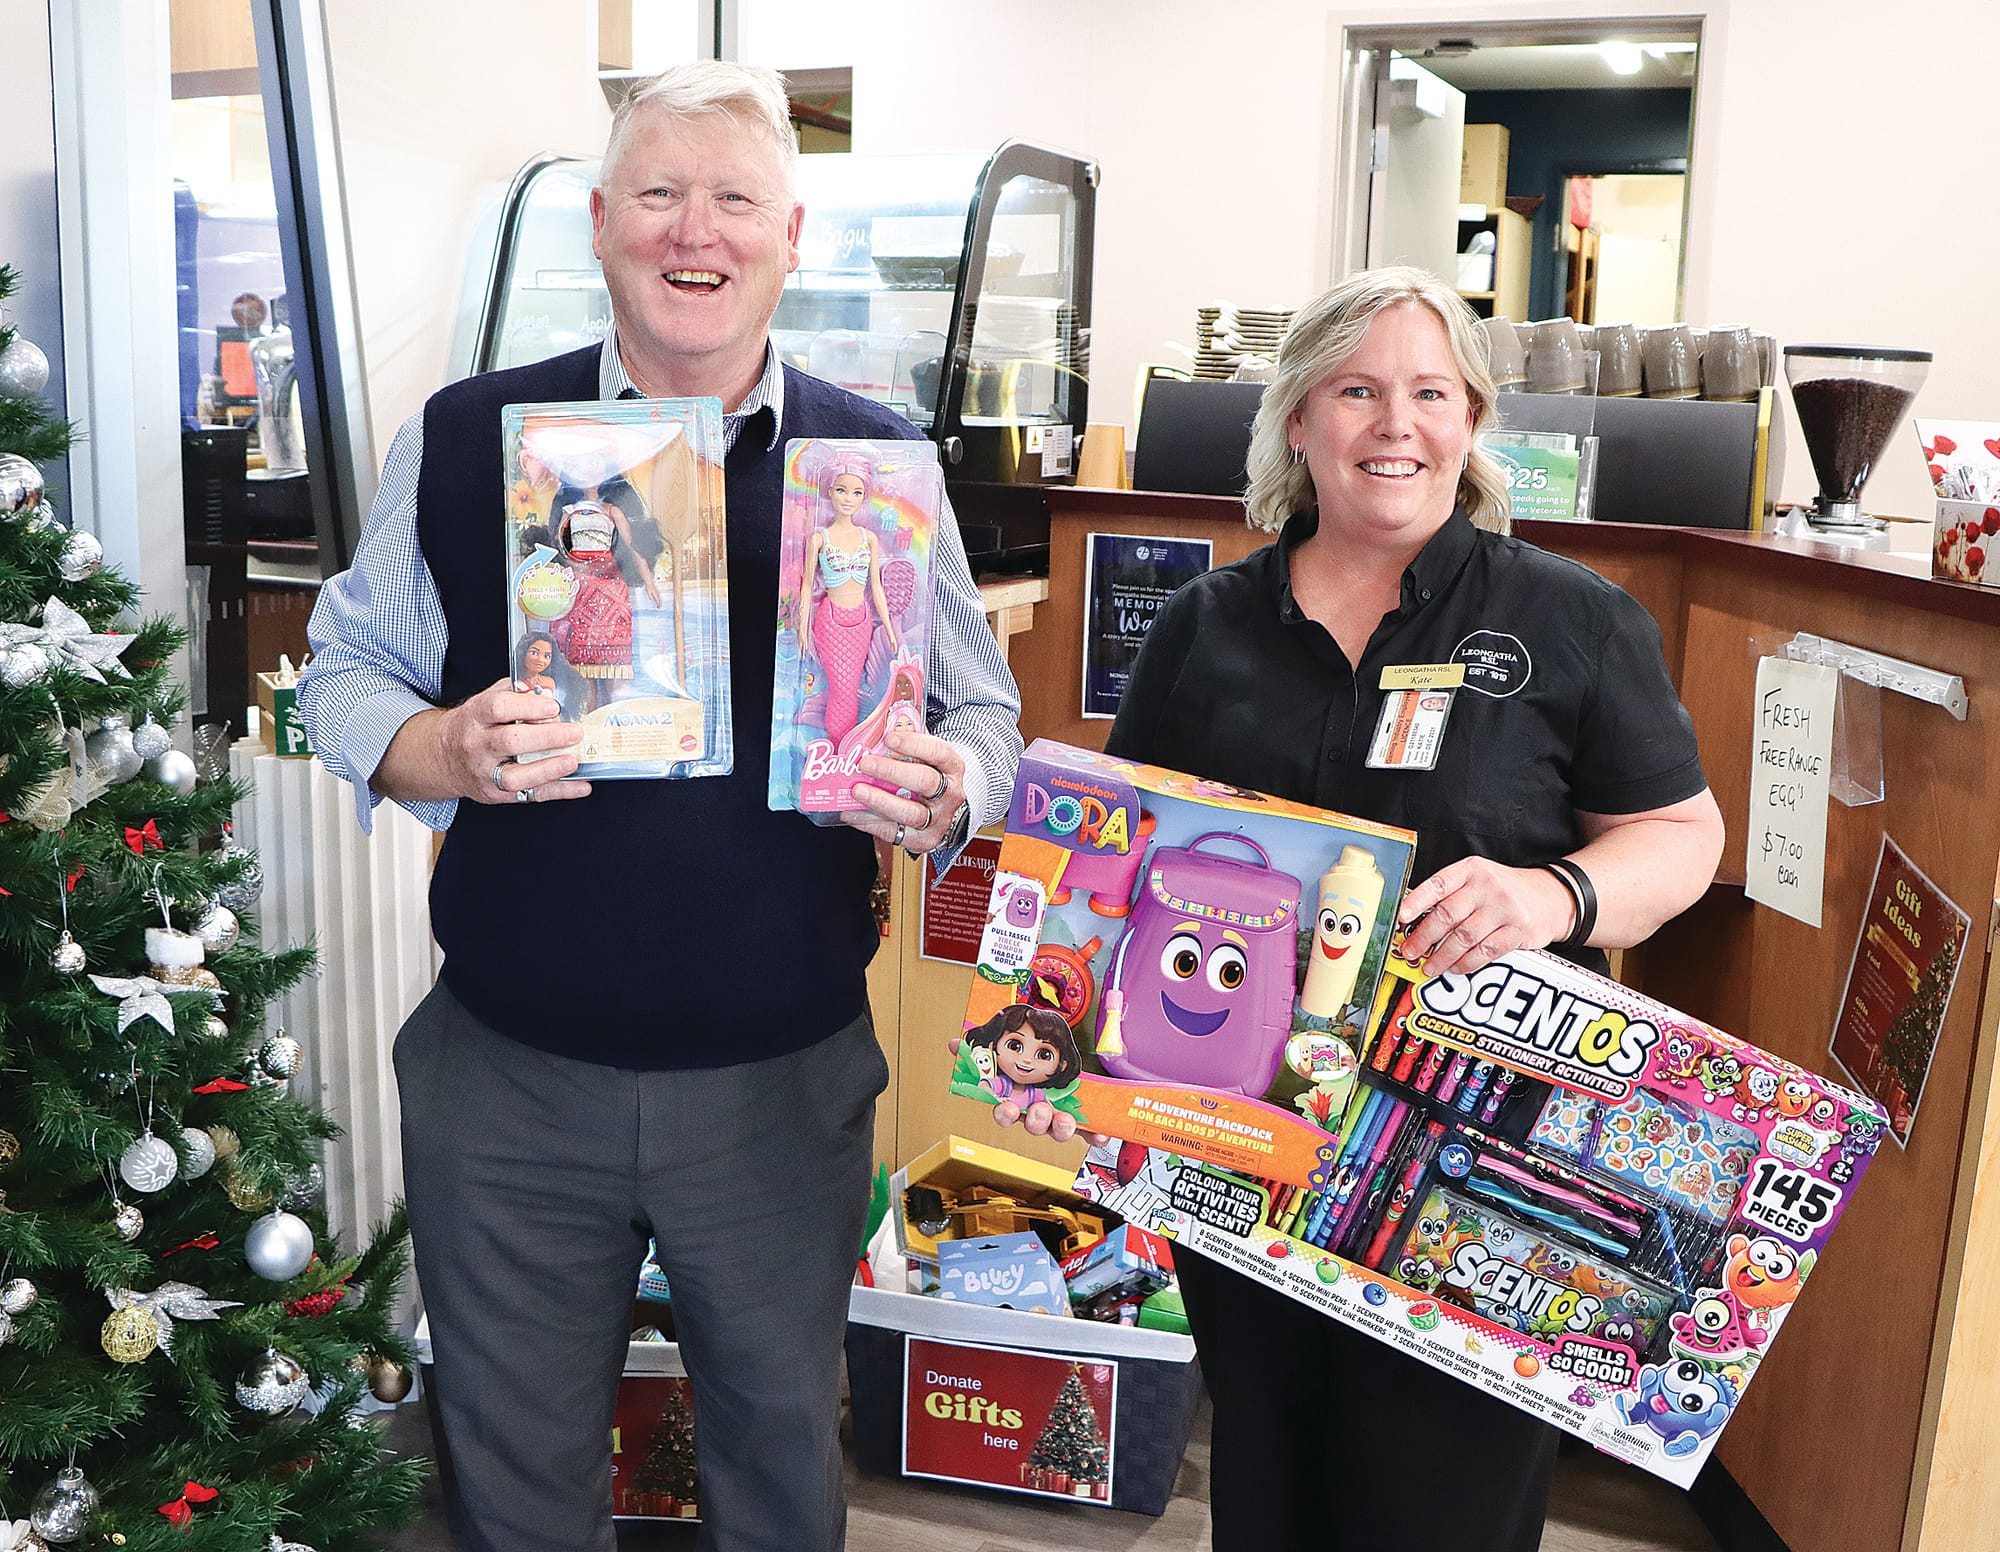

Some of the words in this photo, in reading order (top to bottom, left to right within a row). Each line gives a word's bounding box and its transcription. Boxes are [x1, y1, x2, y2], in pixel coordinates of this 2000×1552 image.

[1510, 495, 1535, 503] ceeds
[1536, 496, 1559, 505] going
[1561, 496, 1570, 504] to
[1530, 507, 1567, 515] Veterans
[1461, 648, 1519, 662] LEONGATHA
[1480, 656, 1499, 665] RSL
[1410, 676, 1433, 685] Kate
[1468, 667, 1487, 676] EST
[661, 711, 673, 725] 2
[1762, 687, 1811, 738] FRESH
[803, 741, 871, 780] Barb
[1050, 776, 1118, 800] nickelodeon
[1024, 782, 1129, 855] DORA
[1761, 825, 1803, 863] $7.00
[1777, 865, 1799, 889] each
[1895, 878, 1922, 919] Gift
[991, 927, 1008, 937] PULL
[1008, 931, 1031, 942] TASSEL
[1882, 896, 1922, 949] Ideas
[993, 942, 1023, 954] POMPON
[1420, 964, 1661, 1077] SCENTOS
[1417, 1015, 1476, 1043] SCENTED
[1476, 1035, 1555, 1074] STATIONERY
[1553, 1063, 1626, 1096] ACTIVITIES
[1127, 1107, 1154, 1123] MON
[1154, 1113, 1176, 1129] SAC
[1184, 1121, 1206, 1137] DOS
[1206, 1125, 1275, 1154] D'AVENTURE
[1133, 1096, 1153, 1109] MY
[1151, 1100, 1215, 1126] ADVENTURE
[1215, 1116, 1274, 1142] BACKPACK
[1160, 1132, 1204, 1152] WARNING:
[1775, 1132, 1815, 1156] WASHABLE
[1785, 1126, 1814, 1144] SUPER
[1321, 1150, 1333, 1158] 3+
[1833, 1163, 1853, 1176] 3+
[1173, 1179, 1260, 1223] ACTIVITIES
[1182, 1169, 1228, 1193] COLOUR
[1229, 1180, 1260, 1206] YOUR
[1752, 1162, 1836, 1223] 145
[1152, 1208, 1177, 1222] Finish
[1173, 1195, 1199, 1214] WITH
[1199, 1203, 1251, 1236] SCENT!
[1748, 1201, 1809, 1238] PIECES
[1441, 1241, 1602, 1333] SCENTOS
[1195, 1237, 1200, 1245] 2
[1202, 1241, 1231, 1260] SCENTED
[1230, 1254, 1257, 1273] TWISTED
[1257, 1267, 1285, 1286] ERASERS
[1291, 1283, 1299, 1294] 10
[1299, 1289, 1327, 1307] SCENTED
[1327, 1301, 1342, 1315] FINE
[1342, 1308, 1357, 1322] LINE
[1357, 1316, 1387, 1336] MARKERS
[1393, 1333, 1398, 1341] 3
[1398, 1336, 1427, 1355] SCENTED
[1426, 1350, 1454, 1369] STICKER
[1453, 1363, 1479, 1380] SHEETS
[1483, 1378, 1491, 1387] 10
[1491, 1381, 1521, 1401] ACTIVITY
[1520, 1395, 1545, 1413] SHEETS
[1550, 1411, 1565, 1423] ART
[1564, 1417, 1582, 1431] CASE
[1204, 1230, 1233, 1250] SCENTED
[1232, 1243, 1248, 1257] MINI
[1247, 1251, 1277, 1272] MARKERS
[1282, 1269, 1288, 1277] 6
[1288, 1271, 1317, 1291] SCENTED
[1316, 1284, 1331, 1297] MINI
[1330, 1292, 1348, 1306] PENS
[1356, 1306, 1384, 1324] SCENTED
[1384, 1318, 1395, 1328] HB
[1394, 1323, 1416, 1340] PENCIL
[1426, 1339, 1455, 1359] SCENTED
[1455, 1352, 1481, 1371] ERASER
[1480, 1364, 1505, 1382] TOPPER
[1515, 1381, 1544, 1401] SCENTED
[1543, 1395, 1573, 1416] RAINBOW
[1572, 1409, 1587, 1422] PEN
[1562, 1341, 1628, 1368] SMELLS
[925, 1369, 983, 1391] Donate
[1551, 1354, 1570, 1370] SO
[1571, 1359, 1632, 1385] GOOD!
[925, 1391, 1024, 1430] Gifts
[983, 1431, 1019, 1450] here
[1613, 1428, 1653, 1453] WARNING:
